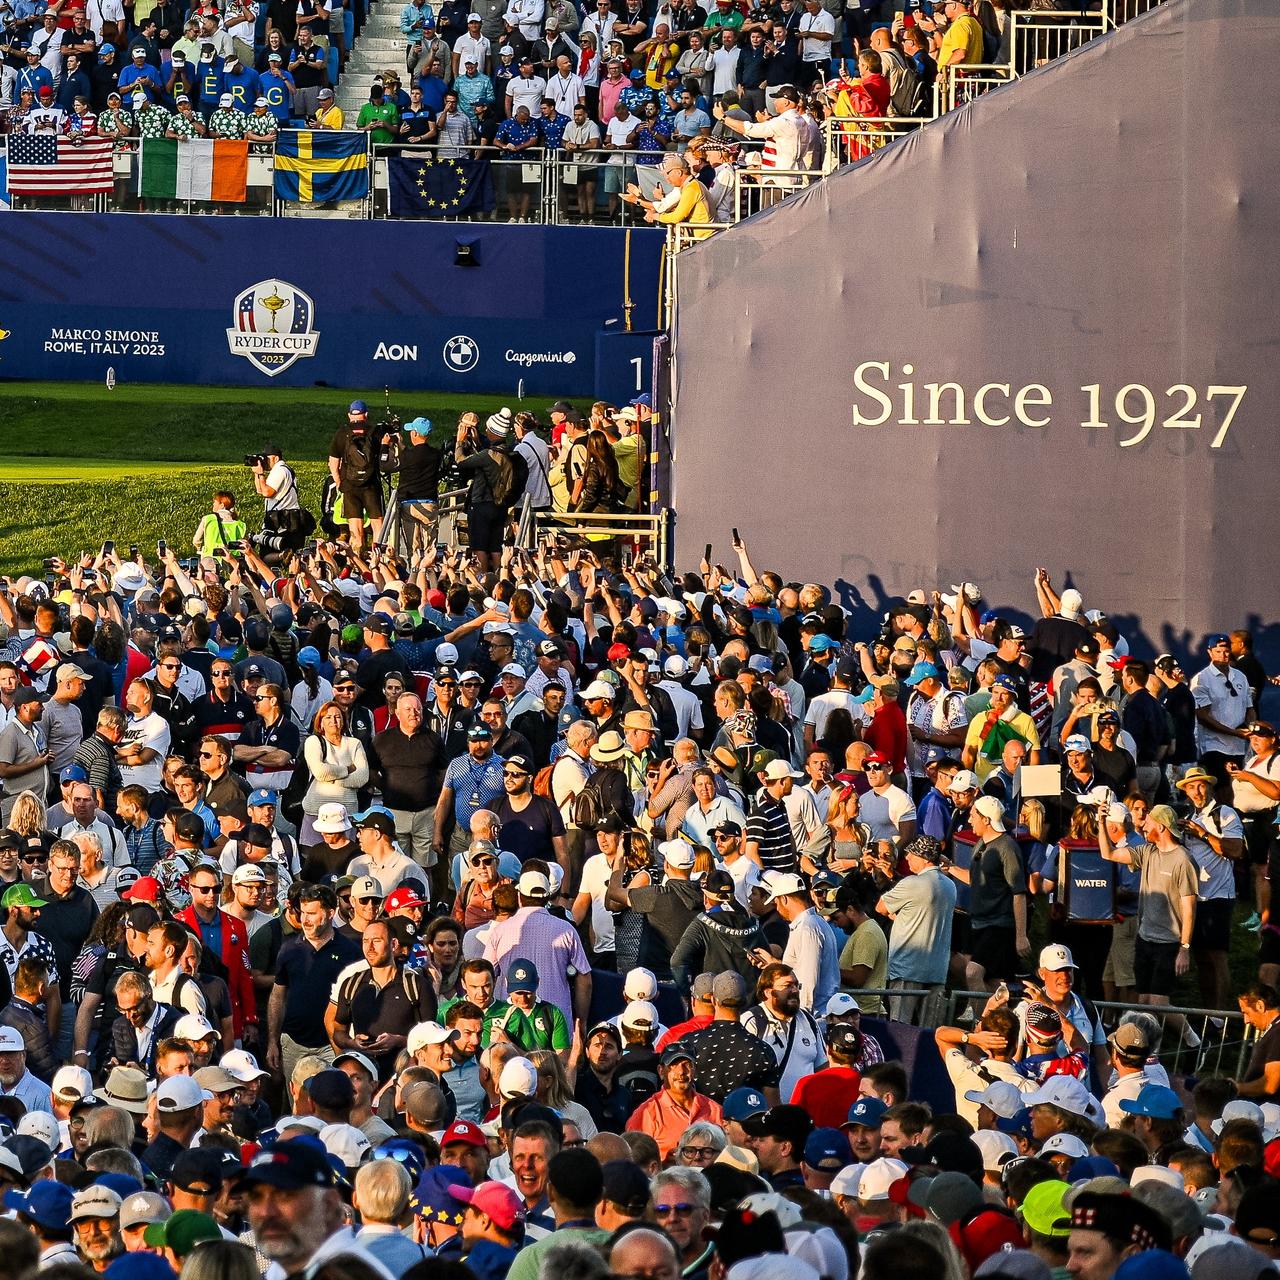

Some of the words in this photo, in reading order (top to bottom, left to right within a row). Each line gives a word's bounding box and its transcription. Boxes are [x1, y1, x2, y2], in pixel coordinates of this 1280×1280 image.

[51, 328, 101, 341] MARCO
[104, 330, 159, 343] SIMONE
[234, 336, 281, 348] RYDER
[283, 337, 312, 349] CUP
[44, 341, 87, 355] ROME,
[90, 342, 130, 354] ITALY
[133, 344, 165, 356] 2023
[373, 342, 418, 361] AON
[261, 355, 285, 364] 2023
[505, 349, 563, 369] Capgemini
[630, 357, 642, 391] 1
[852, 361, 1053, 427] Since
[1080, 382, 1248, 449] 1927
[1075, 879, 1107, 888] WATER
[702, 915, 721, 931] PEAK
